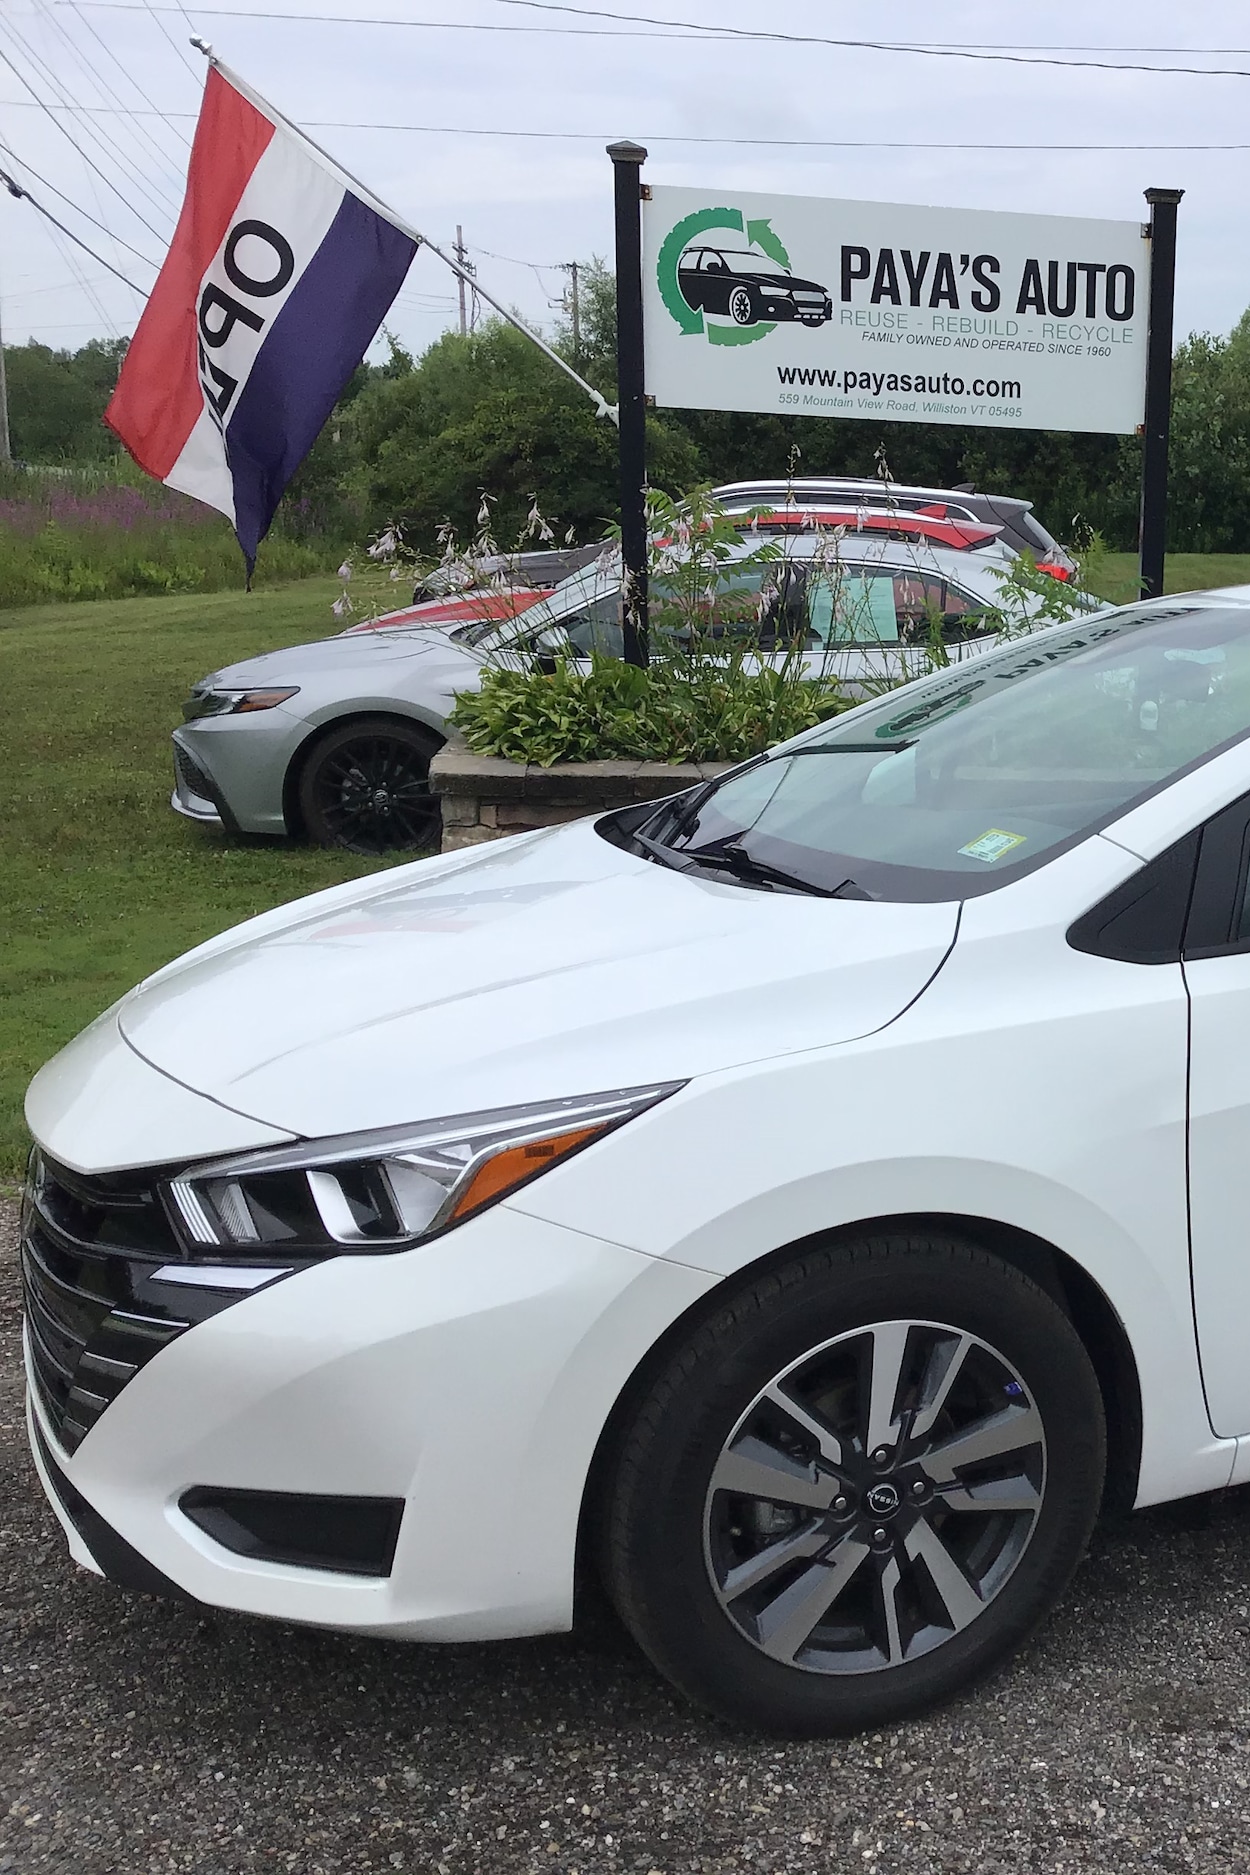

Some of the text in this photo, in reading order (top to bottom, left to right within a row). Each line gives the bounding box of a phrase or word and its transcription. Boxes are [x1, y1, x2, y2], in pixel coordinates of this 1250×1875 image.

[840, 245, 1135, 322] PAYA'S AUTO
[840, 309, 908, 329] REUSE
[932, 315, 1019, 336] REBUILD
[1042, 322, 1134, 344] RECYCLE
[861, 331, 1112, 357] FAMILY OWNED AND OPERATED SINCE 1960
[776, 366, 1021, 398] www.payasauto.com
[778, 393, 1022, 418] 559 Mountain View Road, Williston VT 05495
